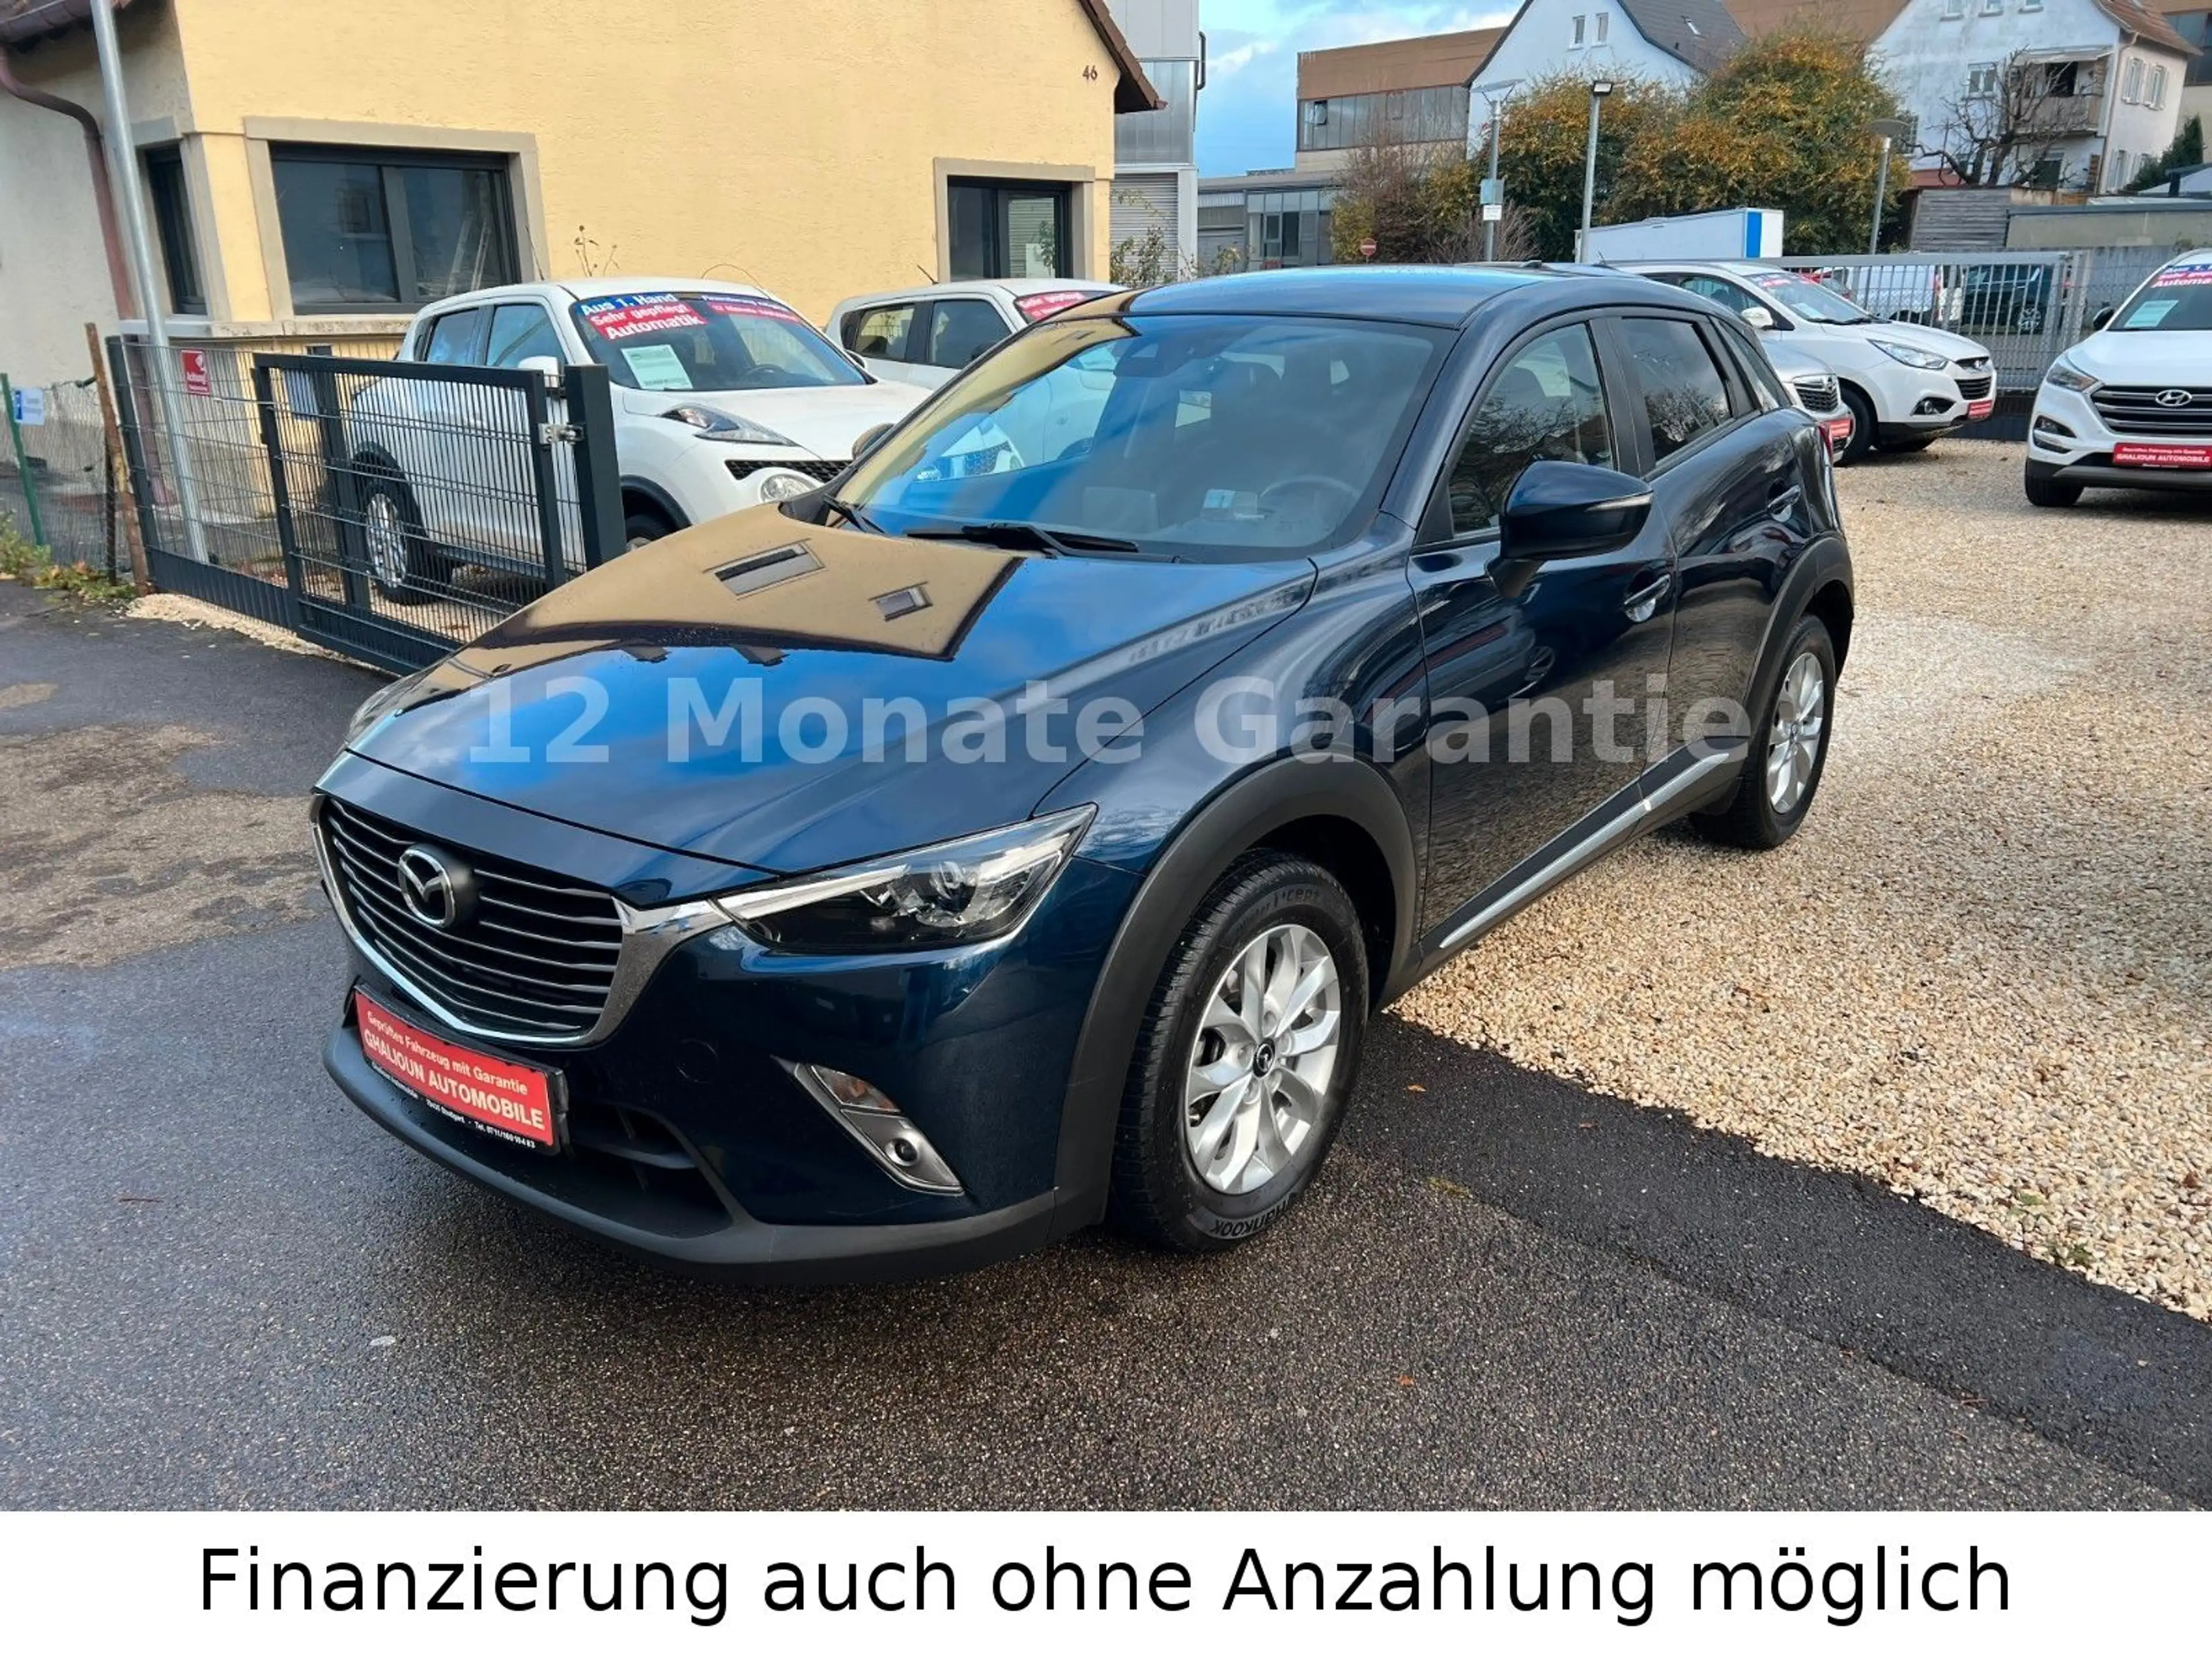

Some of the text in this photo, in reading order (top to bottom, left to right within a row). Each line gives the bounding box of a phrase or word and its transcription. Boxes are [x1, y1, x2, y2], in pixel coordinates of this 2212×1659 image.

[1082, 65, 1098, 81] 46
[581, 293, 679, 316] Aus 1. Hand
[590, 311, 627, 325] Sehr
[630, 304, 691, 319] gepflegt
[605, 314, 708, 340] Automatik
[367, 1010, 528, 1096] Geprüftes Fahrzeug mit Garantie
[363, 1029, 425, 1083] GHALIOUN
[429, 1070, 546, 1131] AUTOMOBILE
